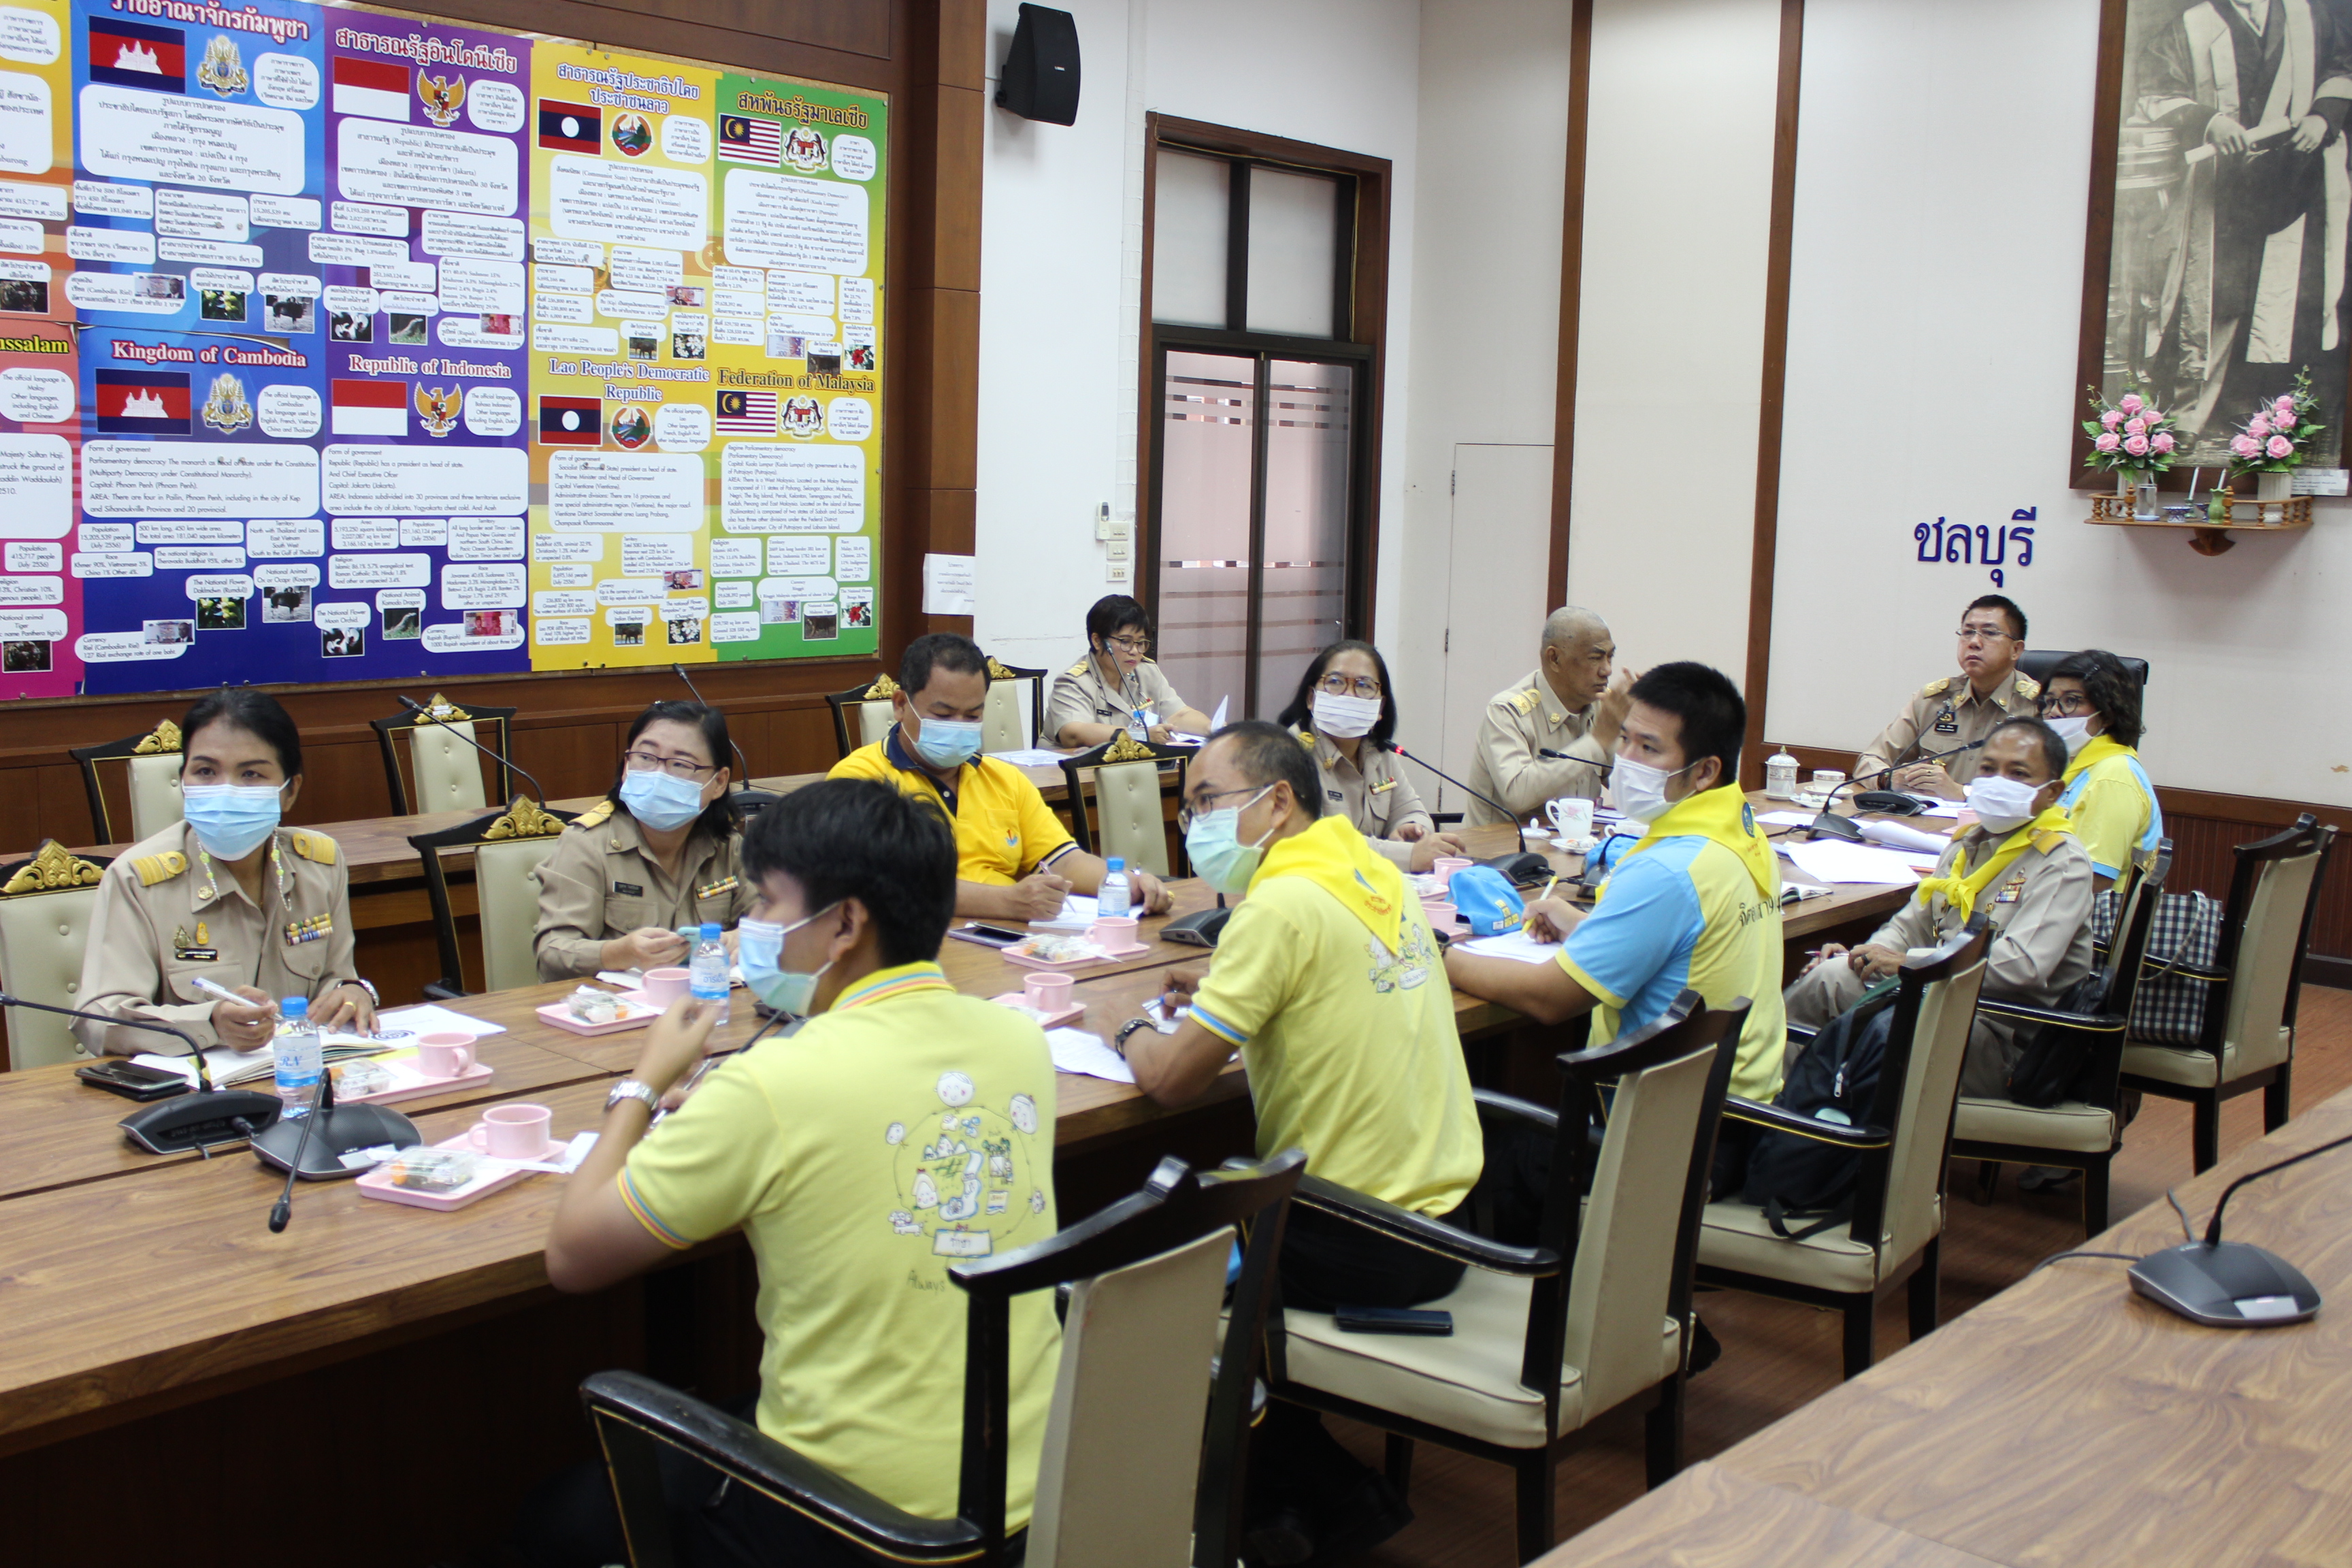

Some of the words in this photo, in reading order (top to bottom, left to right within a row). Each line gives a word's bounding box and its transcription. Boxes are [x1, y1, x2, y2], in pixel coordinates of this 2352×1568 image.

[336, 28, 517, 73] สาธารณรัฐอินโดนีเซีย
[557, 63, 700, 99] สาธารณรัฐประชาธิปไตย
[589, 87, 670, 114] ประชาชนลาว
[737, 91, 868, 129] สหพันธรัฐมาเลเซีย
[112, 340, 195, 363] Kingdom
[200, 346, 218, 363] of
[223, 345, 307, 367] Cambodia
[349, 355, 418, 376] Republic
[421, 358, 438, 375] of
[441, 359, 512, 378] Indonesia
[549, 357, 576, 374] Lao
[580, 359, 634, 380] People's
[637, 363, 710, 381] Democratic
[717, 368, 794, 388] Federation
[797, 373, 813, 389] of
[816, 374, 875, 395] Malaysia
[604, 384, 662, 404] Republic
[1914, 506, 2037, 588] ชลบุรี
